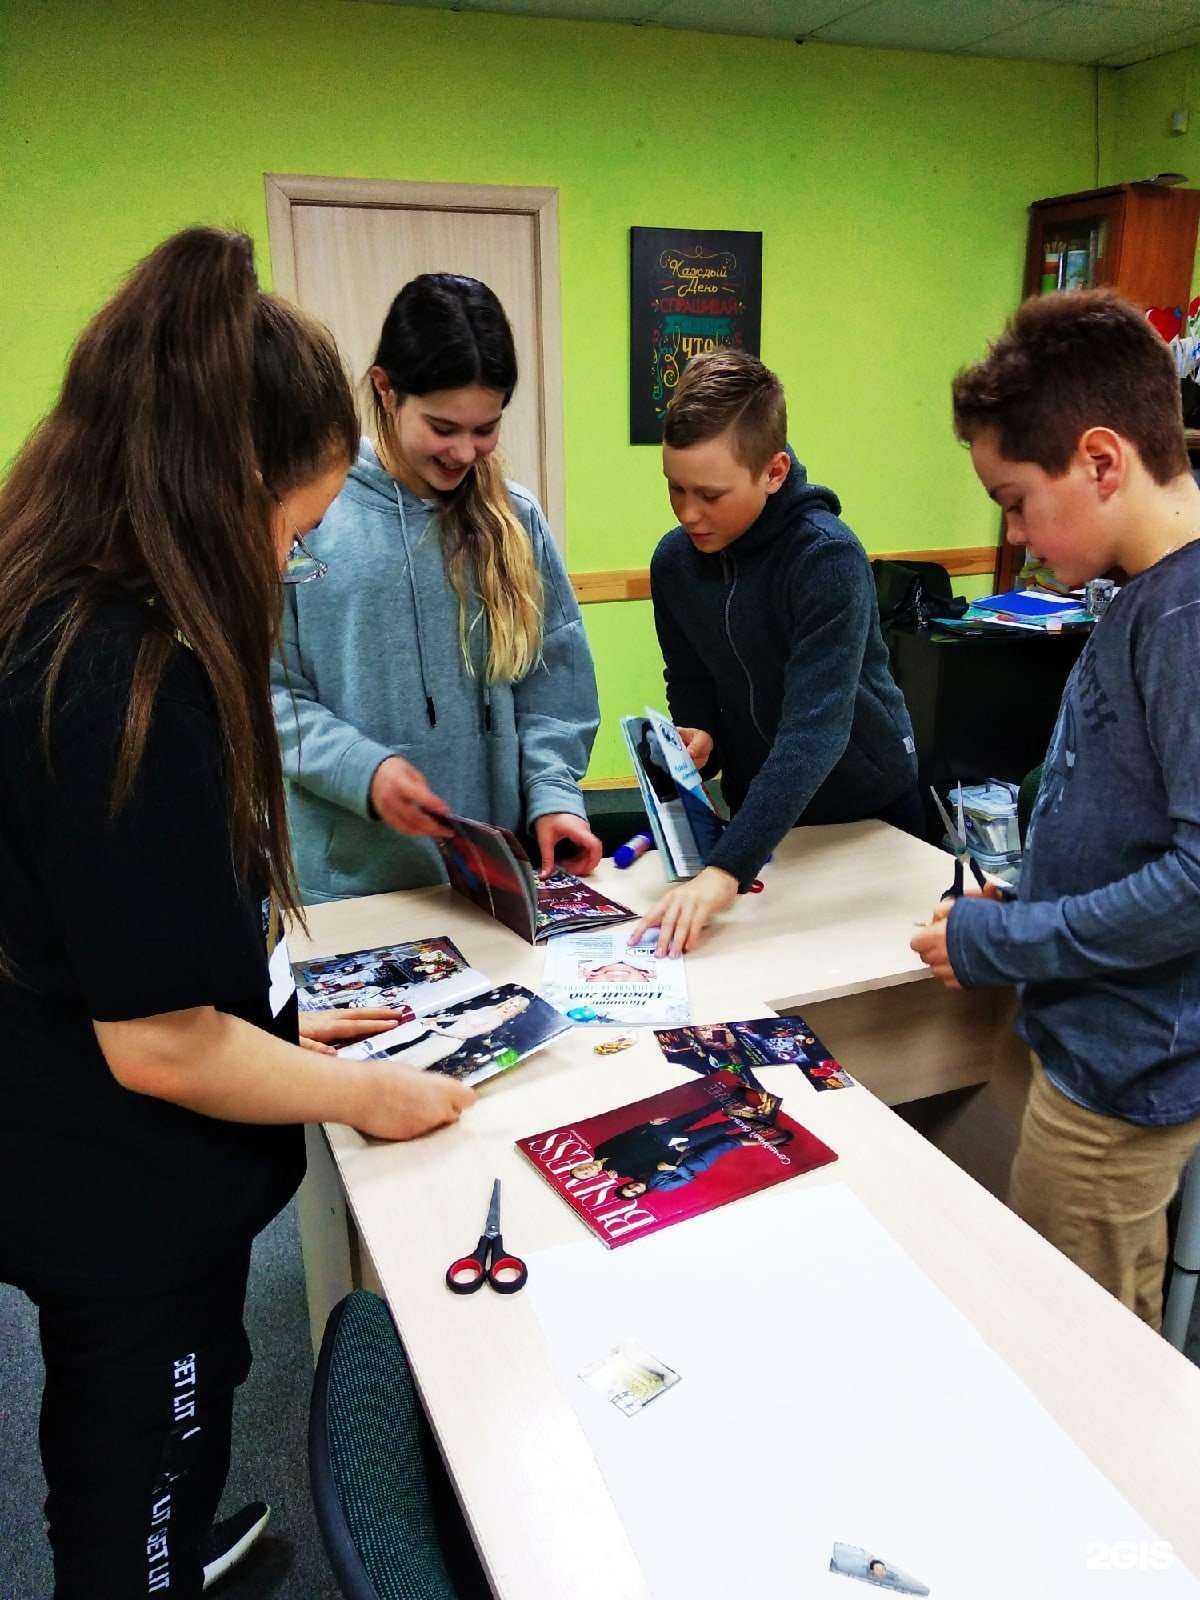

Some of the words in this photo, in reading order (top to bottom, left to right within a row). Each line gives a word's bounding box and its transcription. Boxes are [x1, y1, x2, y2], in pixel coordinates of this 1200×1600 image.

[669, 259, 727, 279] Каждый
[678, 277, 718, 297] День
[174, 1389, 195, 1422] LIT
